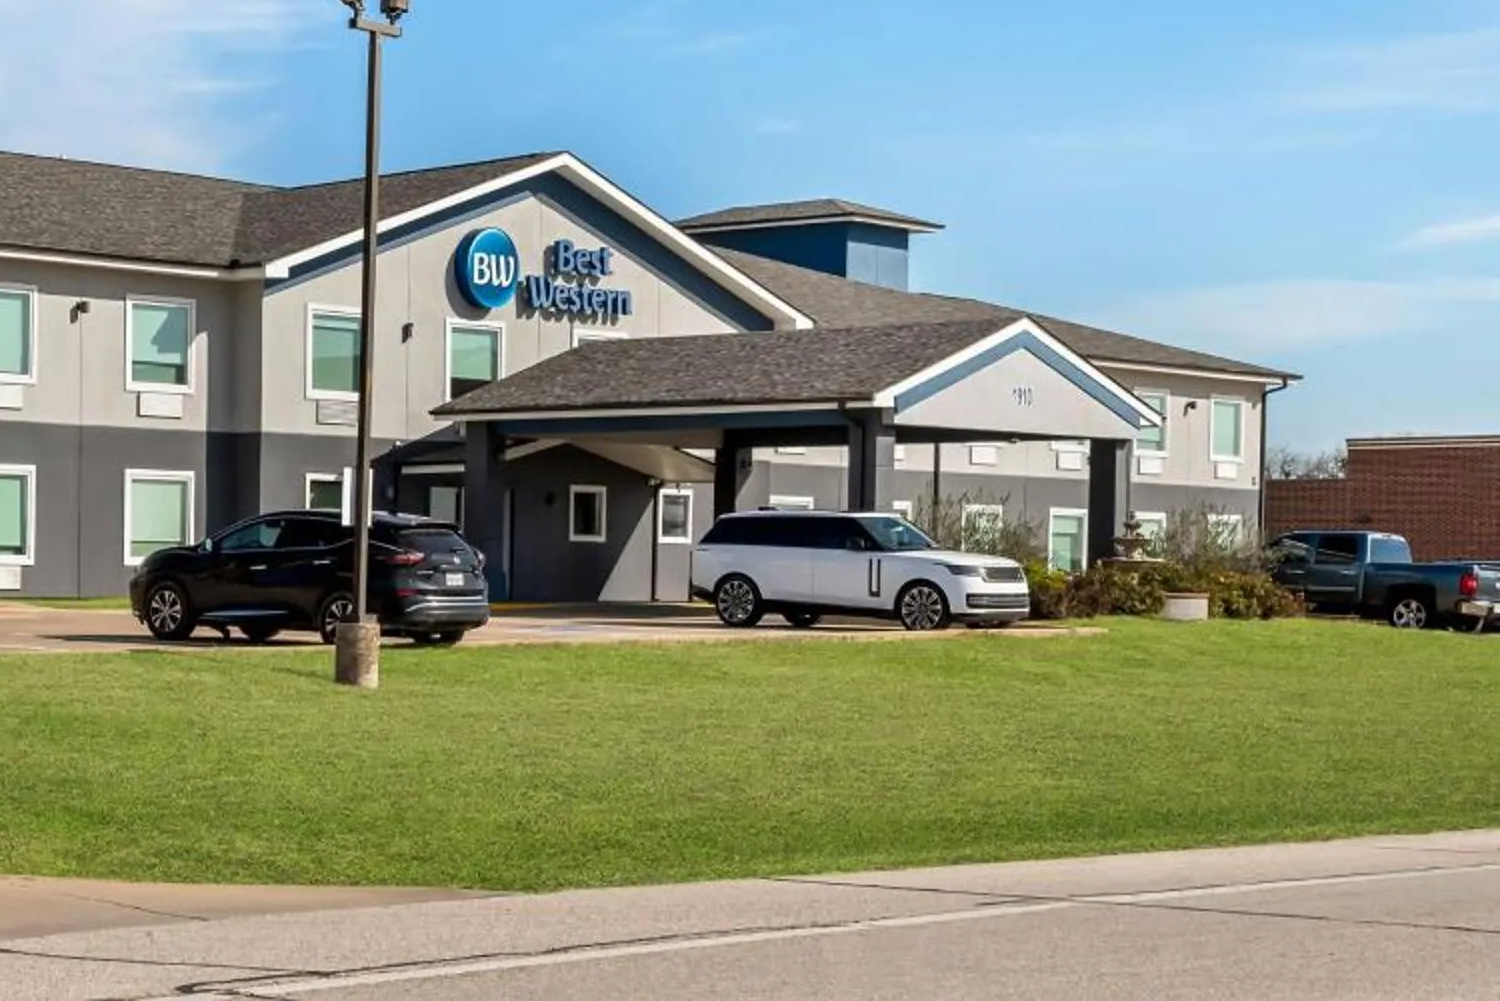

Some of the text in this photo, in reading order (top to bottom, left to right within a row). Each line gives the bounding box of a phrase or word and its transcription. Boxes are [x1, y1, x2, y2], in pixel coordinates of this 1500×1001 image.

[473, 252, 515, 287] BW
[555, 239, 613, 276] Best
[527, 274, 633, 316] Western
